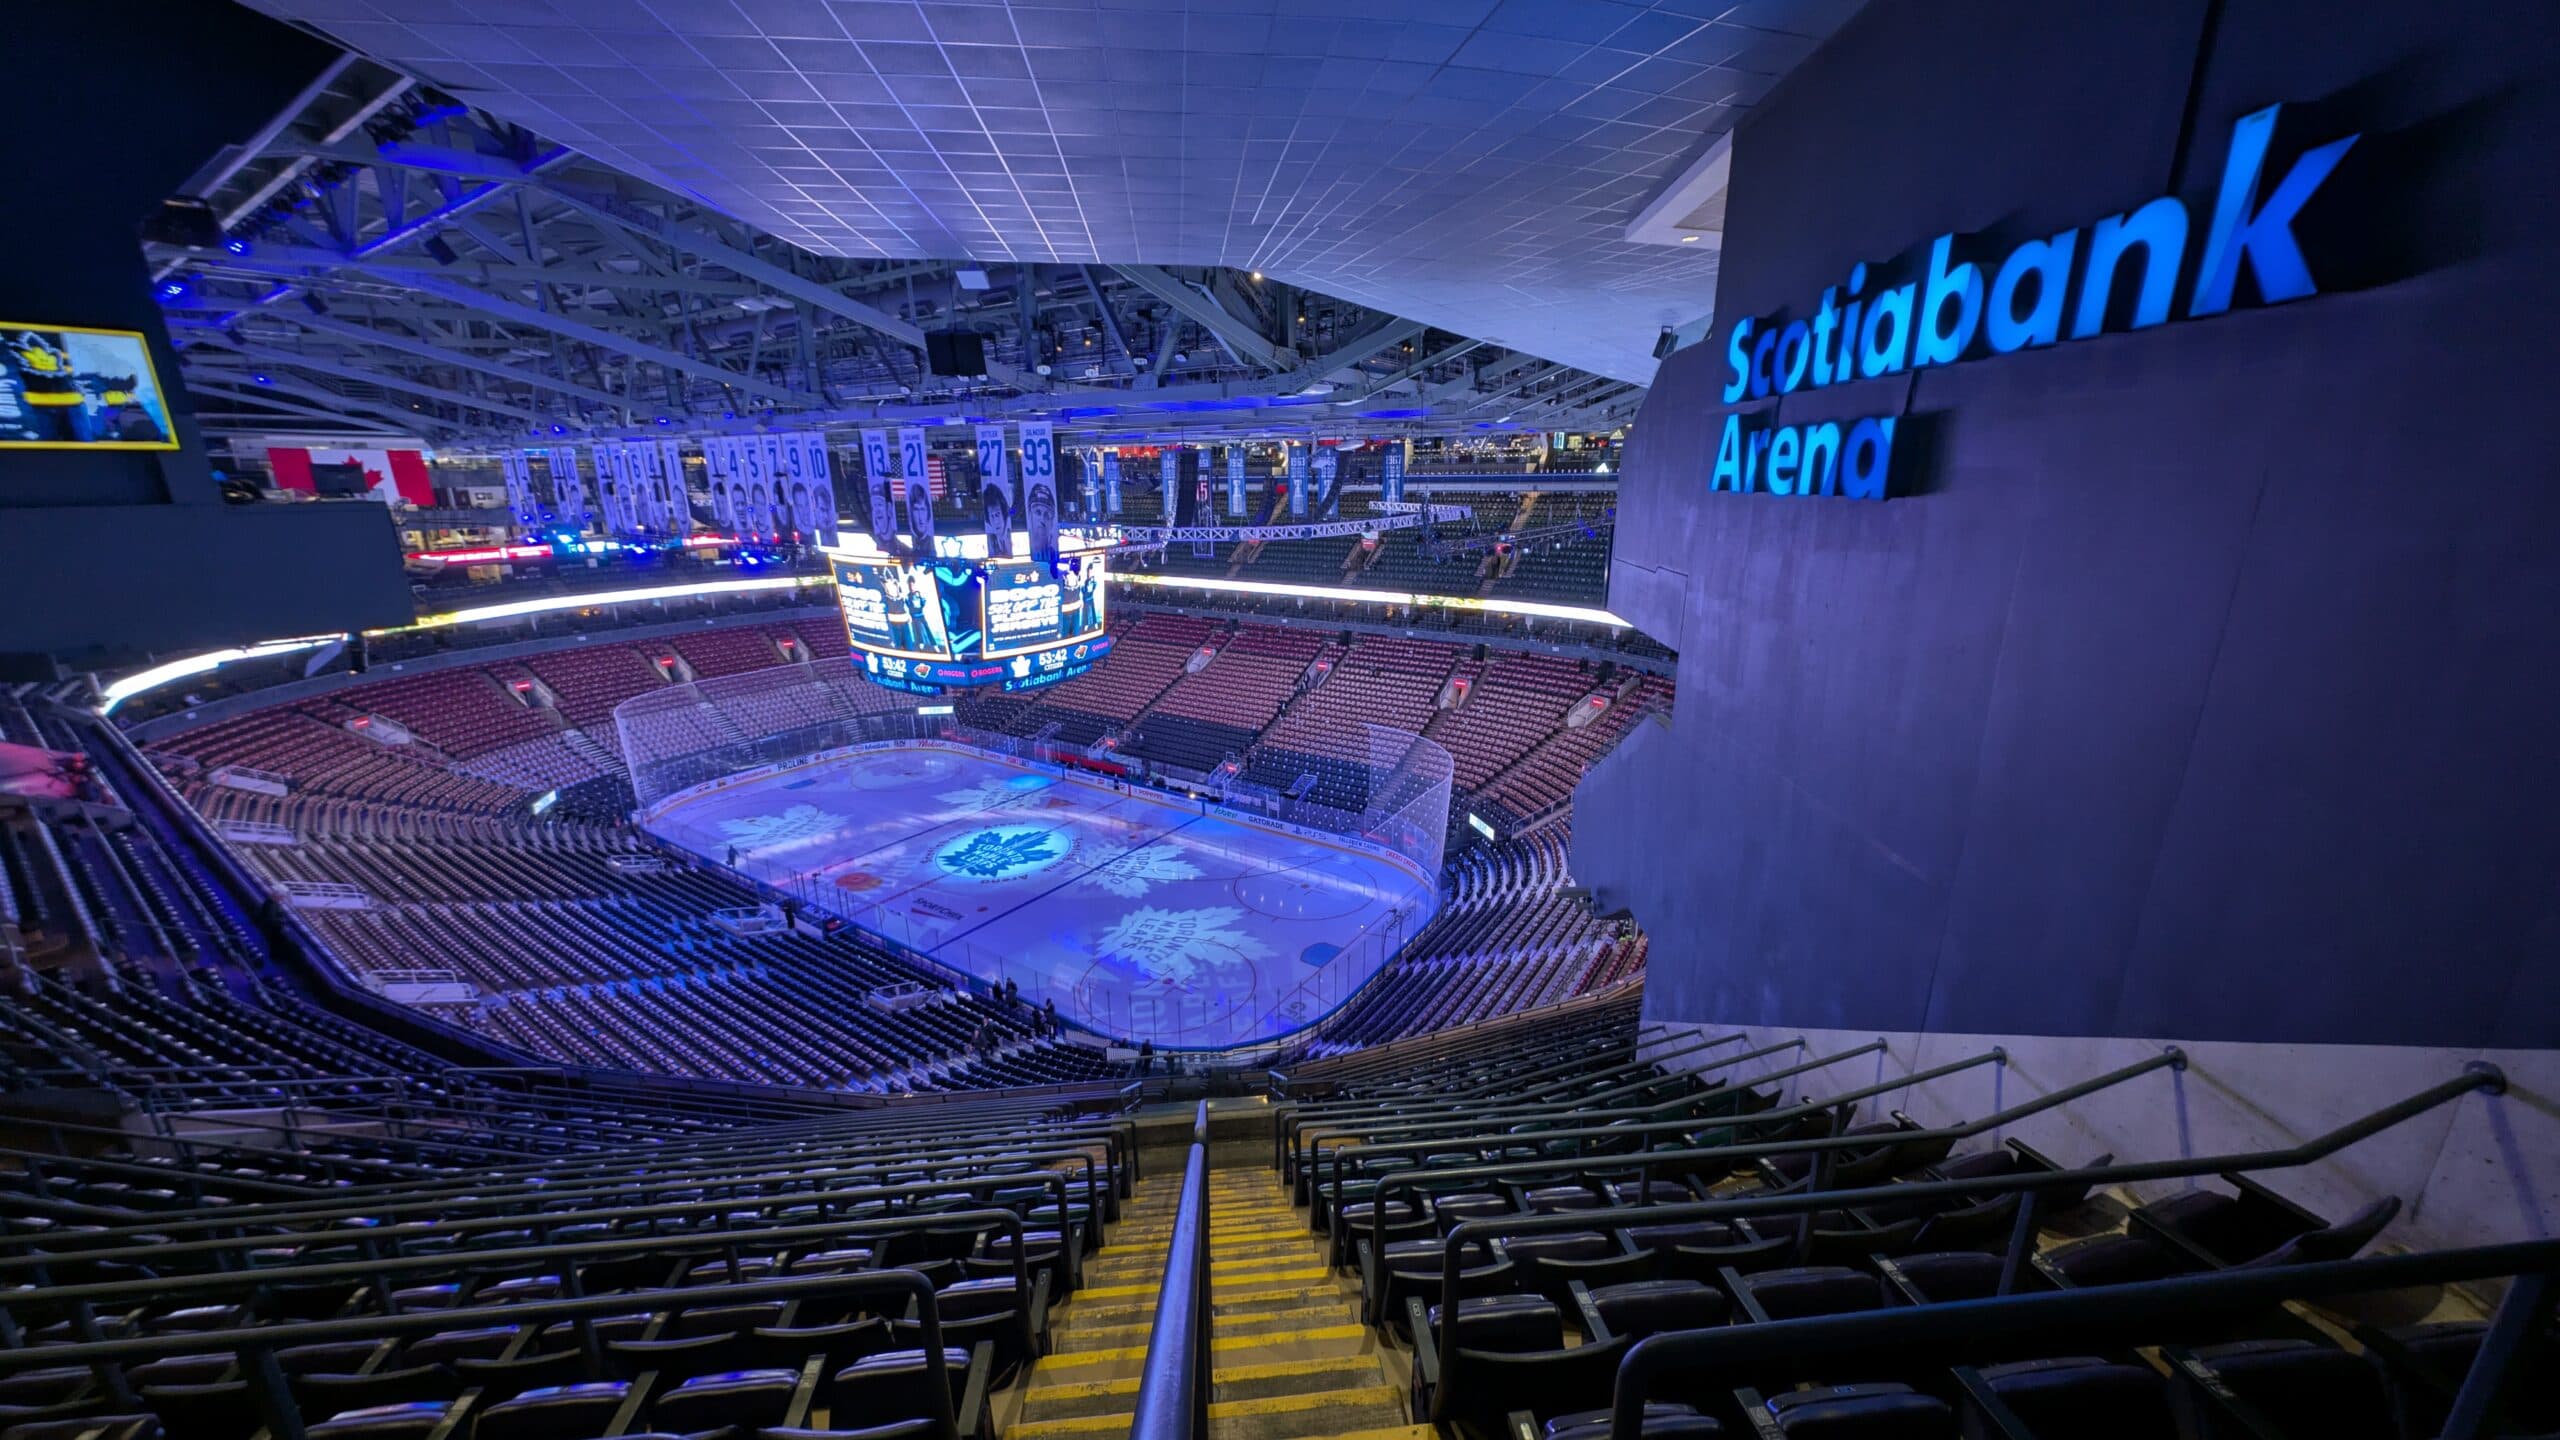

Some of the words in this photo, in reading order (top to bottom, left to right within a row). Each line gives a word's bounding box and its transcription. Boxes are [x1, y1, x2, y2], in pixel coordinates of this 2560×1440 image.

[1723, 102, 2362, 405] Scotiabank
[614, 455, 623, 479] 7
[632, 454, 642, 479] 6
[668, 454, 678, 480] 1
[729, 450, 738, 477] 4
[749, 450, 759, 478] 5
[789, 447, 800, 477] 9
[809, 447, 826, 479] 10
[868, 444, 886, 477] 13
[904, 443, 924, 477] 21
[978, 440, 1003, 476] 27
[1023, 438, 1052, 476] 93
[1711, 414, 1896, 500] Arena
[1248, 815, 1284, 830] GATORADE
[976, 843, 1025, 863] TORONTO
[1121, 917, 1160, 950] LEAFS
[1138, 919, 1177, 953] MAPLE
[1145, 916, 1197, 964] TORONTO
